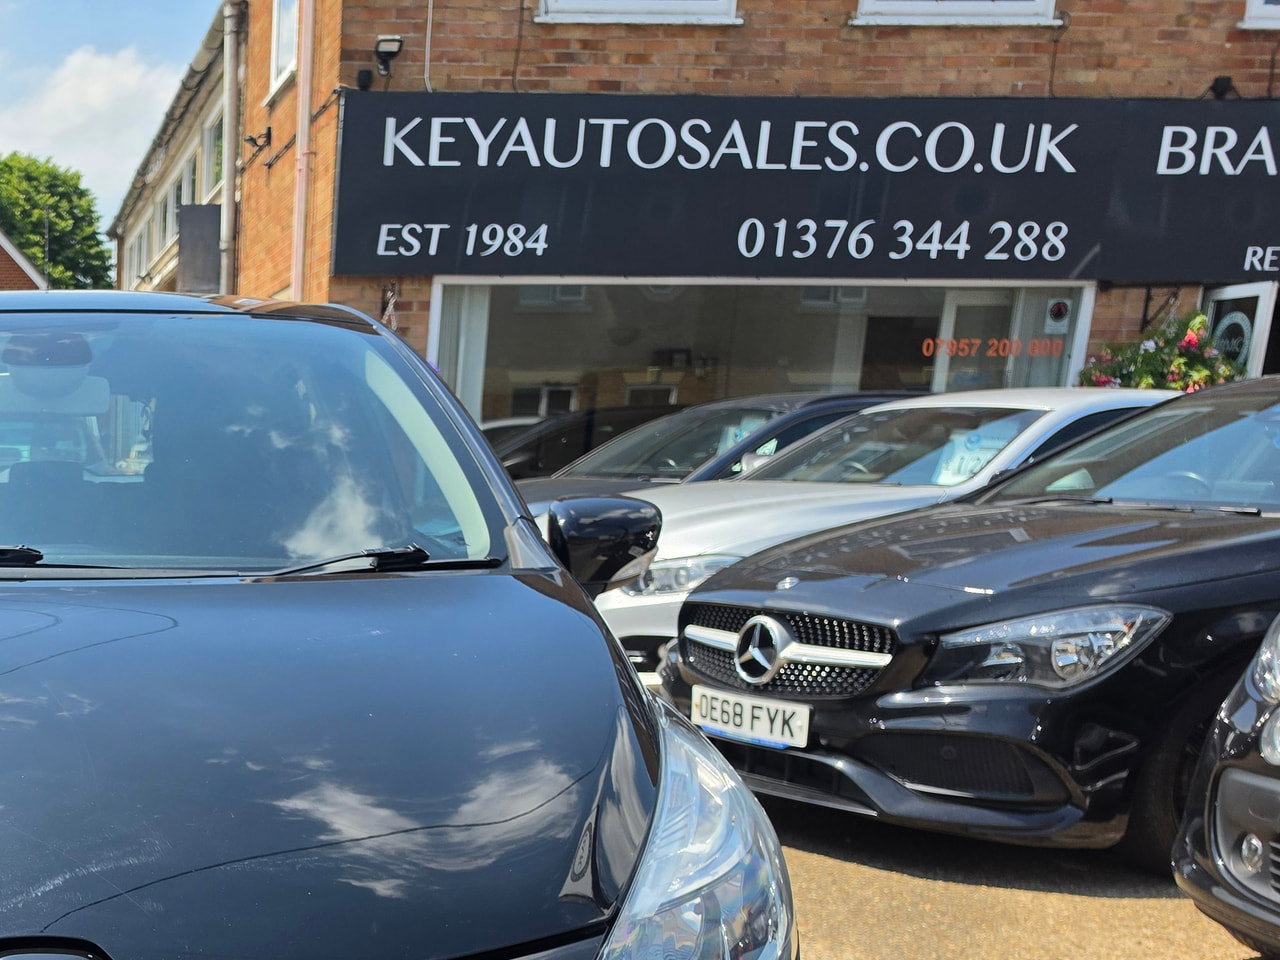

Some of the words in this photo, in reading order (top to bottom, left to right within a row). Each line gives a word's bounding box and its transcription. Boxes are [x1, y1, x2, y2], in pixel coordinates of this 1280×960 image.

[382, 116, 1080, 174] KEYAUTOSALES.CO.UK
[1156, 125, 1278, 175] BRA
[376, 223, 451, 257] EST
[465, 223, 549, 257] 1984
[737, 217, 876, 259] 01376
[888, 219, 971, 260] 344
[984, 220, 1069, 261] 288
[1243, 246, 1280, 271] RE
[922, 338, 982, 357] 07957
[986, 338, 1022, 357] 200
[700, 694, 743, 727] OE68
[750, 705, 796, 738] FYK
